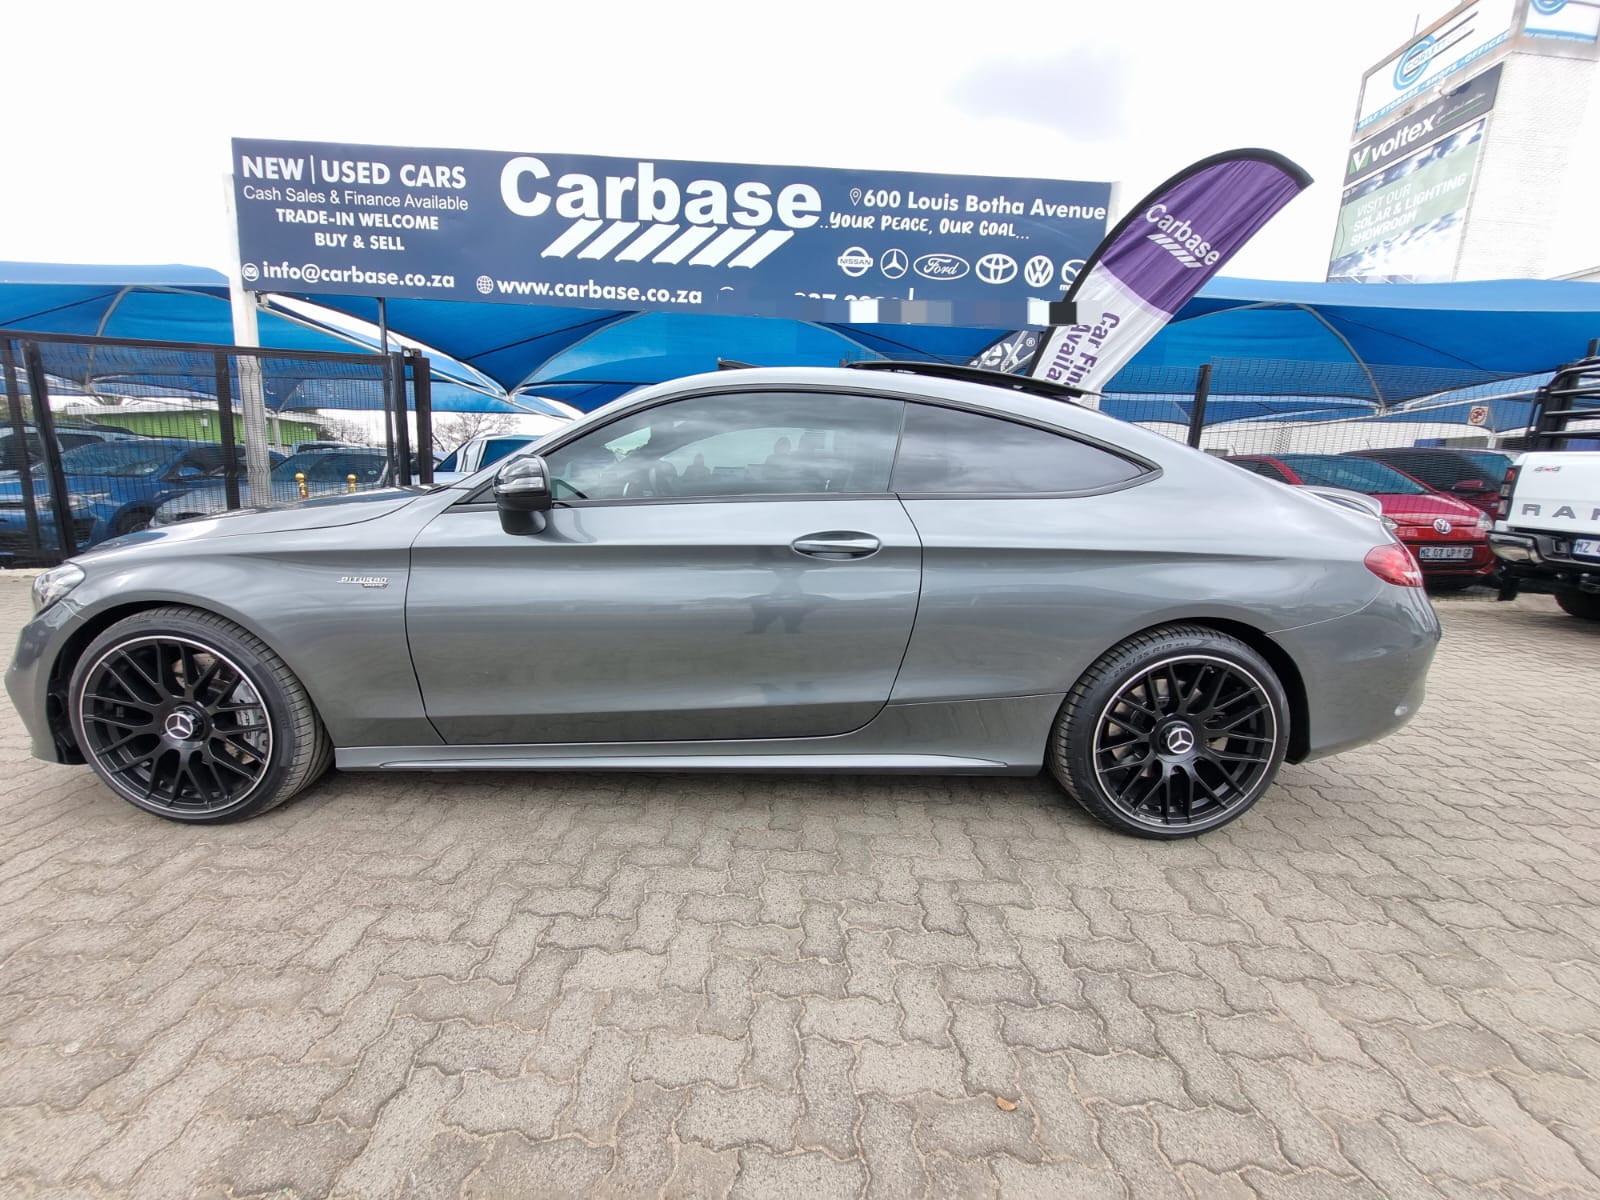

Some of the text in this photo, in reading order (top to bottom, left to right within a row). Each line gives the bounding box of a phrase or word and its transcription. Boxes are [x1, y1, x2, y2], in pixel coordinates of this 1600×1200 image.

[242, 155, 467, 188] NEW USED CARS
[243, 185, 469, 210] Cash Sales & Finance Available
[500, 156, 822, 229] Carbase
[863, 190, 1107, 220] 600 Louis Botha Avenue
[1354, 206, 1394, 233] SOLAR
[1405, 174, 1467, 209] LIGHTING
[1358, 183, 1412, 218] VISIT OUR
[275, 208, 439, 230] TRADE-IN WELCOME
[880, 215, 933, 235] PEACE,
[939, 218, 974, 235] OUR
[1351, 210, 1418, 247] SHOWROOM
[314, 232, 405, 251] BUY & SELL
[1145, 204, 1220, 266] Carbase
[263, 262, 455, 288] info@carbase.co.za
[839, 258, 872, 266] NISSAN
[923, 258, 958, 276] Ford
[496, 279, 703, 305] www.carbase.co.za
[1088, 312, 1120, 348] Car
